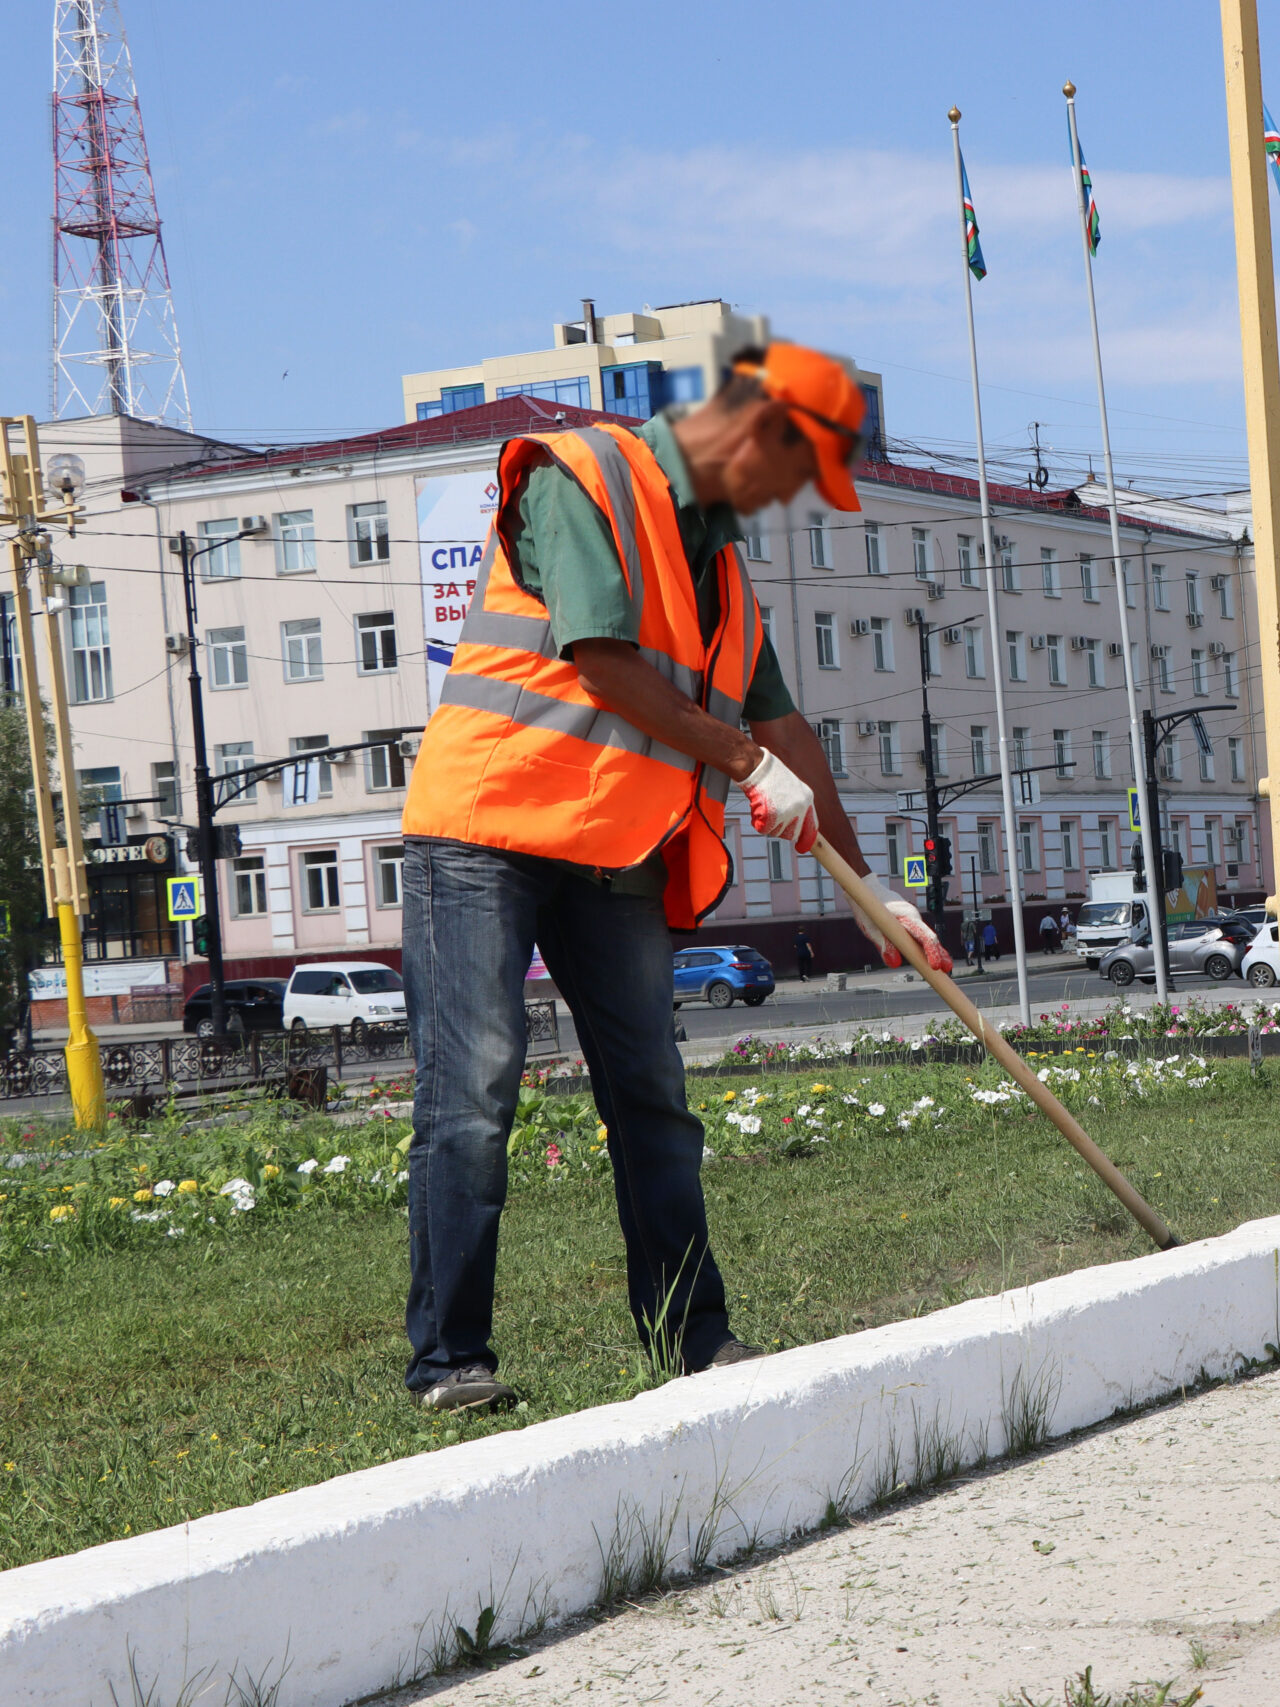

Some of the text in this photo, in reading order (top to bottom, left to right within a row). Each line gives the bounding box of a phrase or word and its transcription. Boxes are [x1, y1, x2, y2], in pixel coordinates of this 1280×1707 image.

[432, 545, 482, 570] СПА
[433, 582, 460, 599] ЗА
[435, 604, 466, 622] ВЫ
